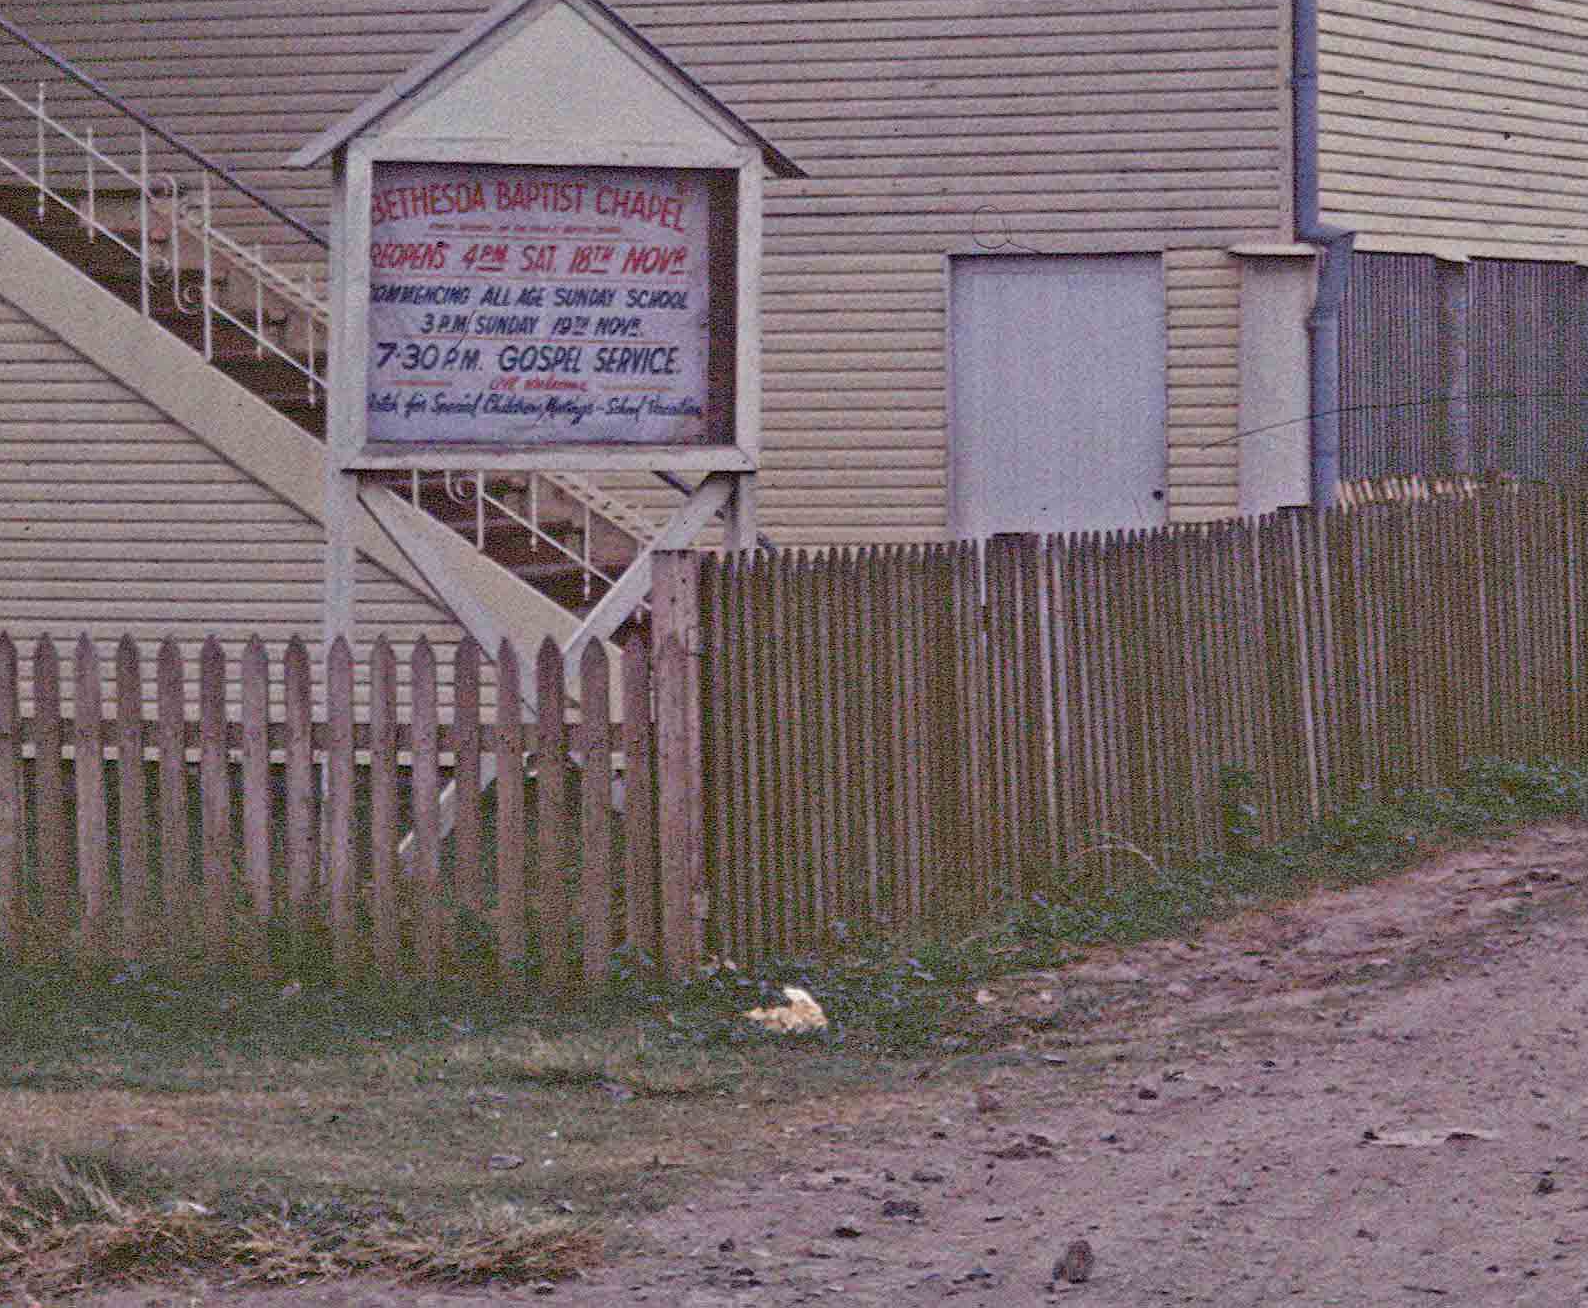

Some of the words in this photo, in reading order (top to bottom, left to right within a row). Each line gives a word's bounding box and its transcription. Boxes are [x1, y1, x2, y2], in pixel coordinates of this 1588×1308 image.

[370, 181, 486, 227] BETHESDA
[497, 179, 586, 213] BAPTIST
[595, 185, 685, 233] CHAPEL
[479, 284, 511, 307] ALL
[514, 286, 548, 307] AGE
[553, 286, 615, 308] SUNDAY
[625, 289, 689, 310] SCHOOL
[420, 312, 435, 335] 3
[474, 314, 540, 336] SUNDAY
[498, 344, 582, 373] GOSPEL
